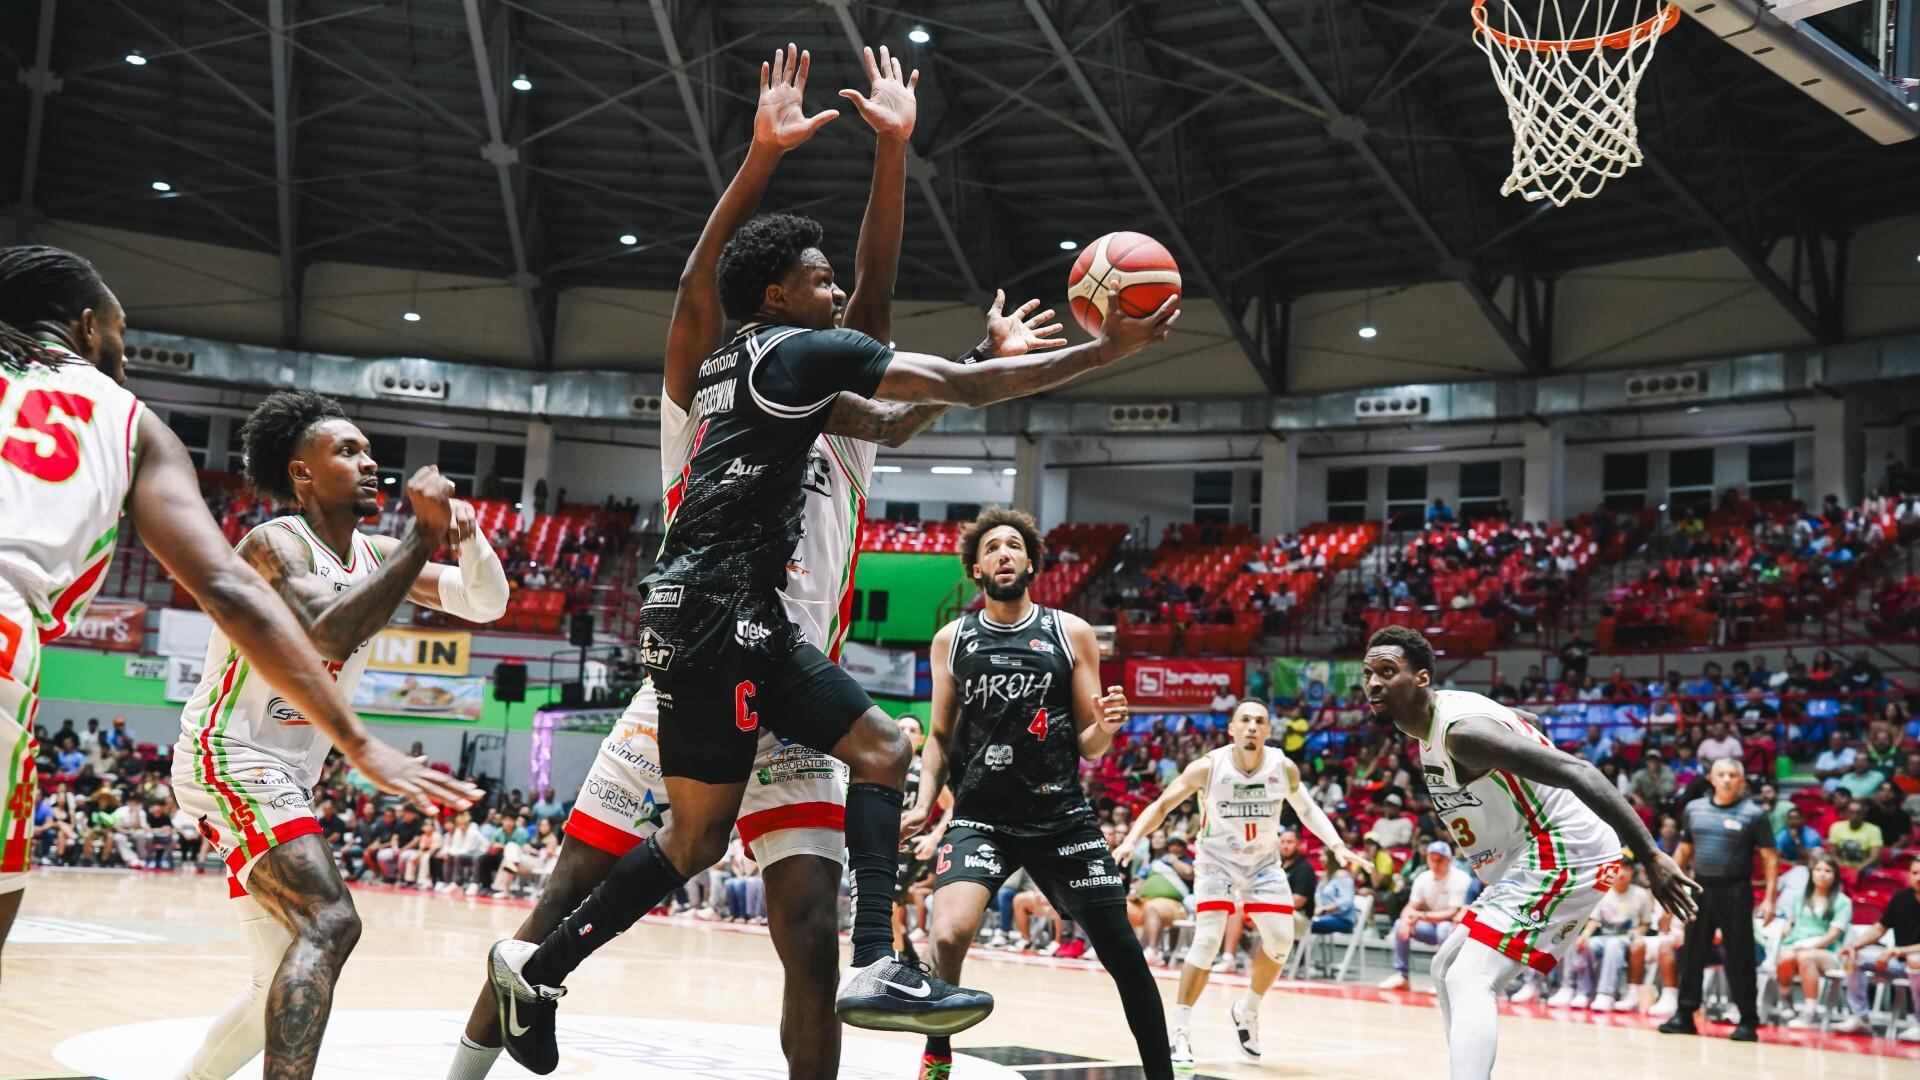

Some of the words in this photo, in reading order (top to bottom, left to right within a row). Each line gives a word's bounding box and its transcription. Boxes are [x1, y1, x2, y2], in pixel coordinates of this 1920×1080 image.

[697, 378, 738, 418] GOODWIN
[735, 679, 759, 732] C
[1027, 707, 1049, 741] 4
[606, 741, 664, 776] windma
[768, 759, 836, 774] LABORATORIO
[586, 779, 639, 813] TOURISM
[620, 786, 641, 802] RICO
[601, 802, 634, 819] COMPANY
[1058, 838, 1103, 857] Walmart
[964, 854, 1002, 875] Wendy's
[1069, 875, 1123, 889] CARIBBEAN
